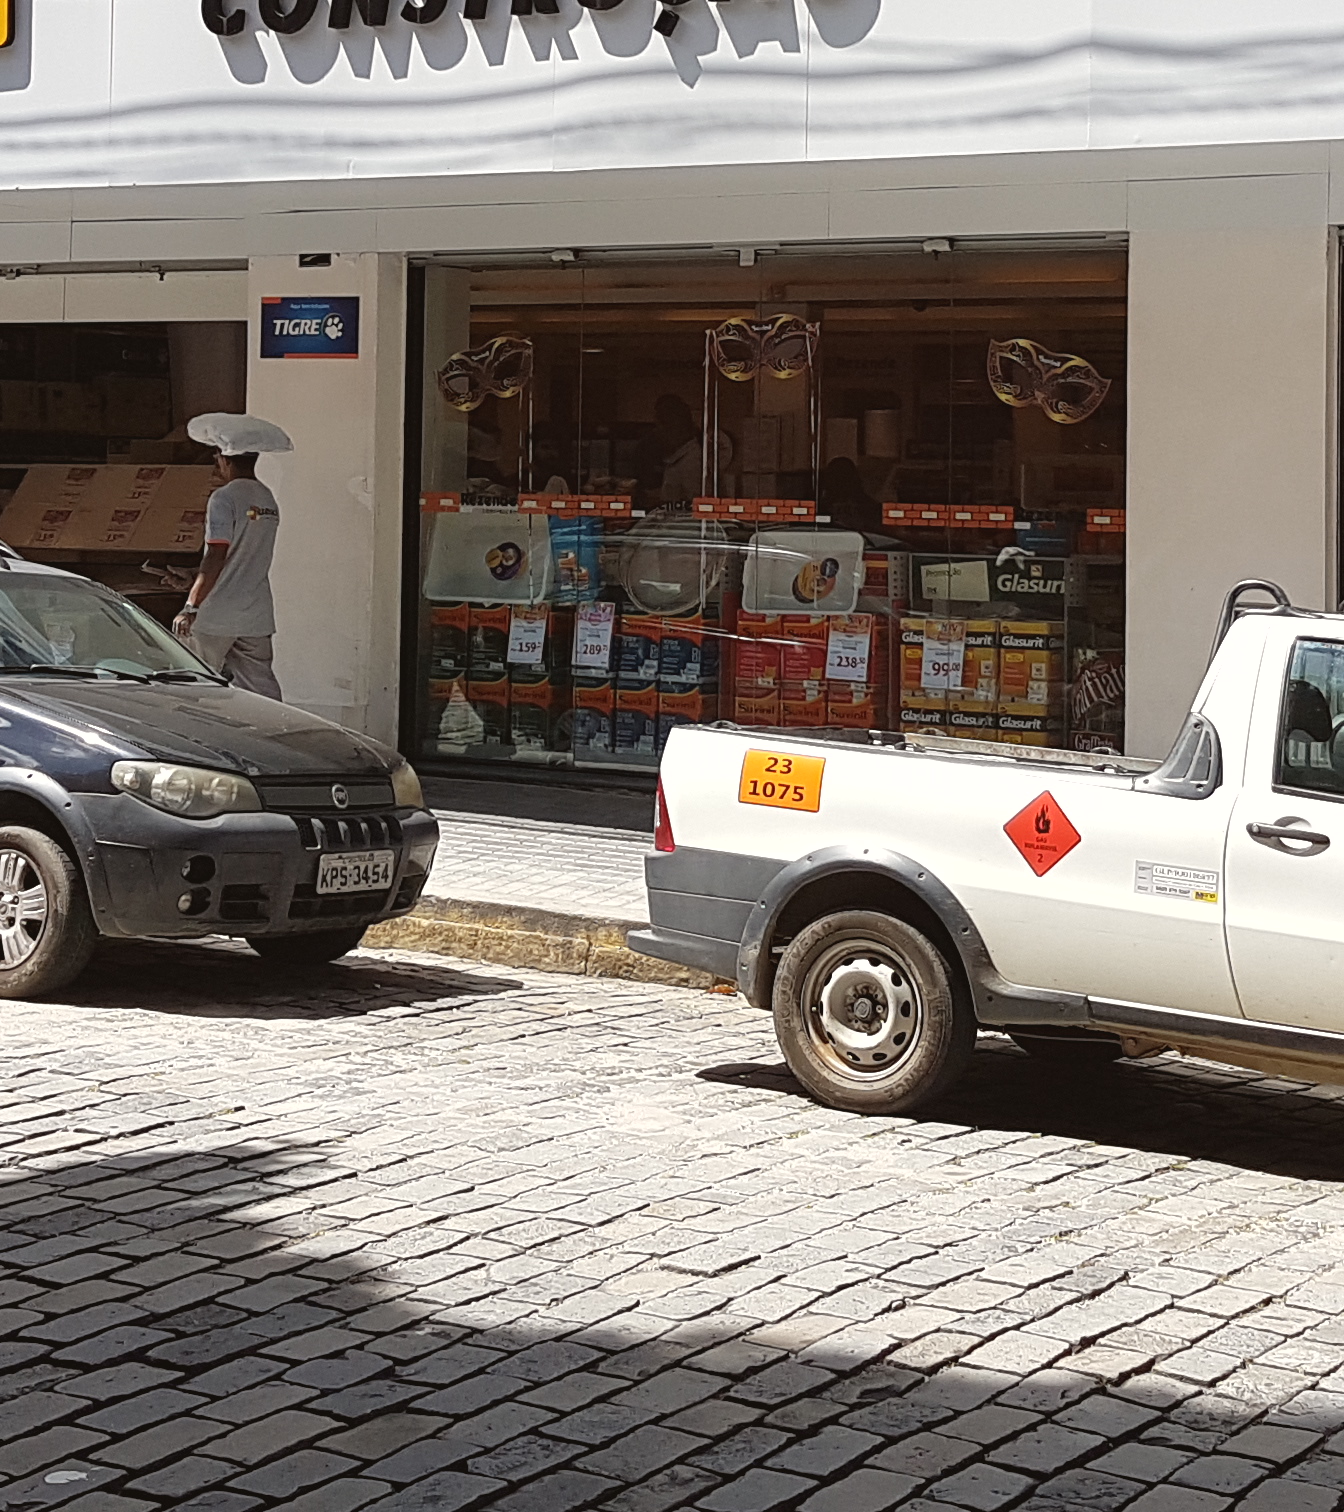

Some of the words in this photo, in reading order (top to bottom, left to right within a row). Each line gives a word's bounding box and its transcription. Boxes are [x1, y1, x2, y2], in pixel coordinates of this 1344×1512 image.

[273, 319, 322, 335] TIGRE
[1002, 636, 1044, 648] Glasurit
[901, 711, 941, 723] Glasurit
[1000, 717, 1041, 729] Glasurit
[765, 757, 792, 774] 23
[748, 780, 804, 802] 1075
[1037, 853, 1043, 863] 2
